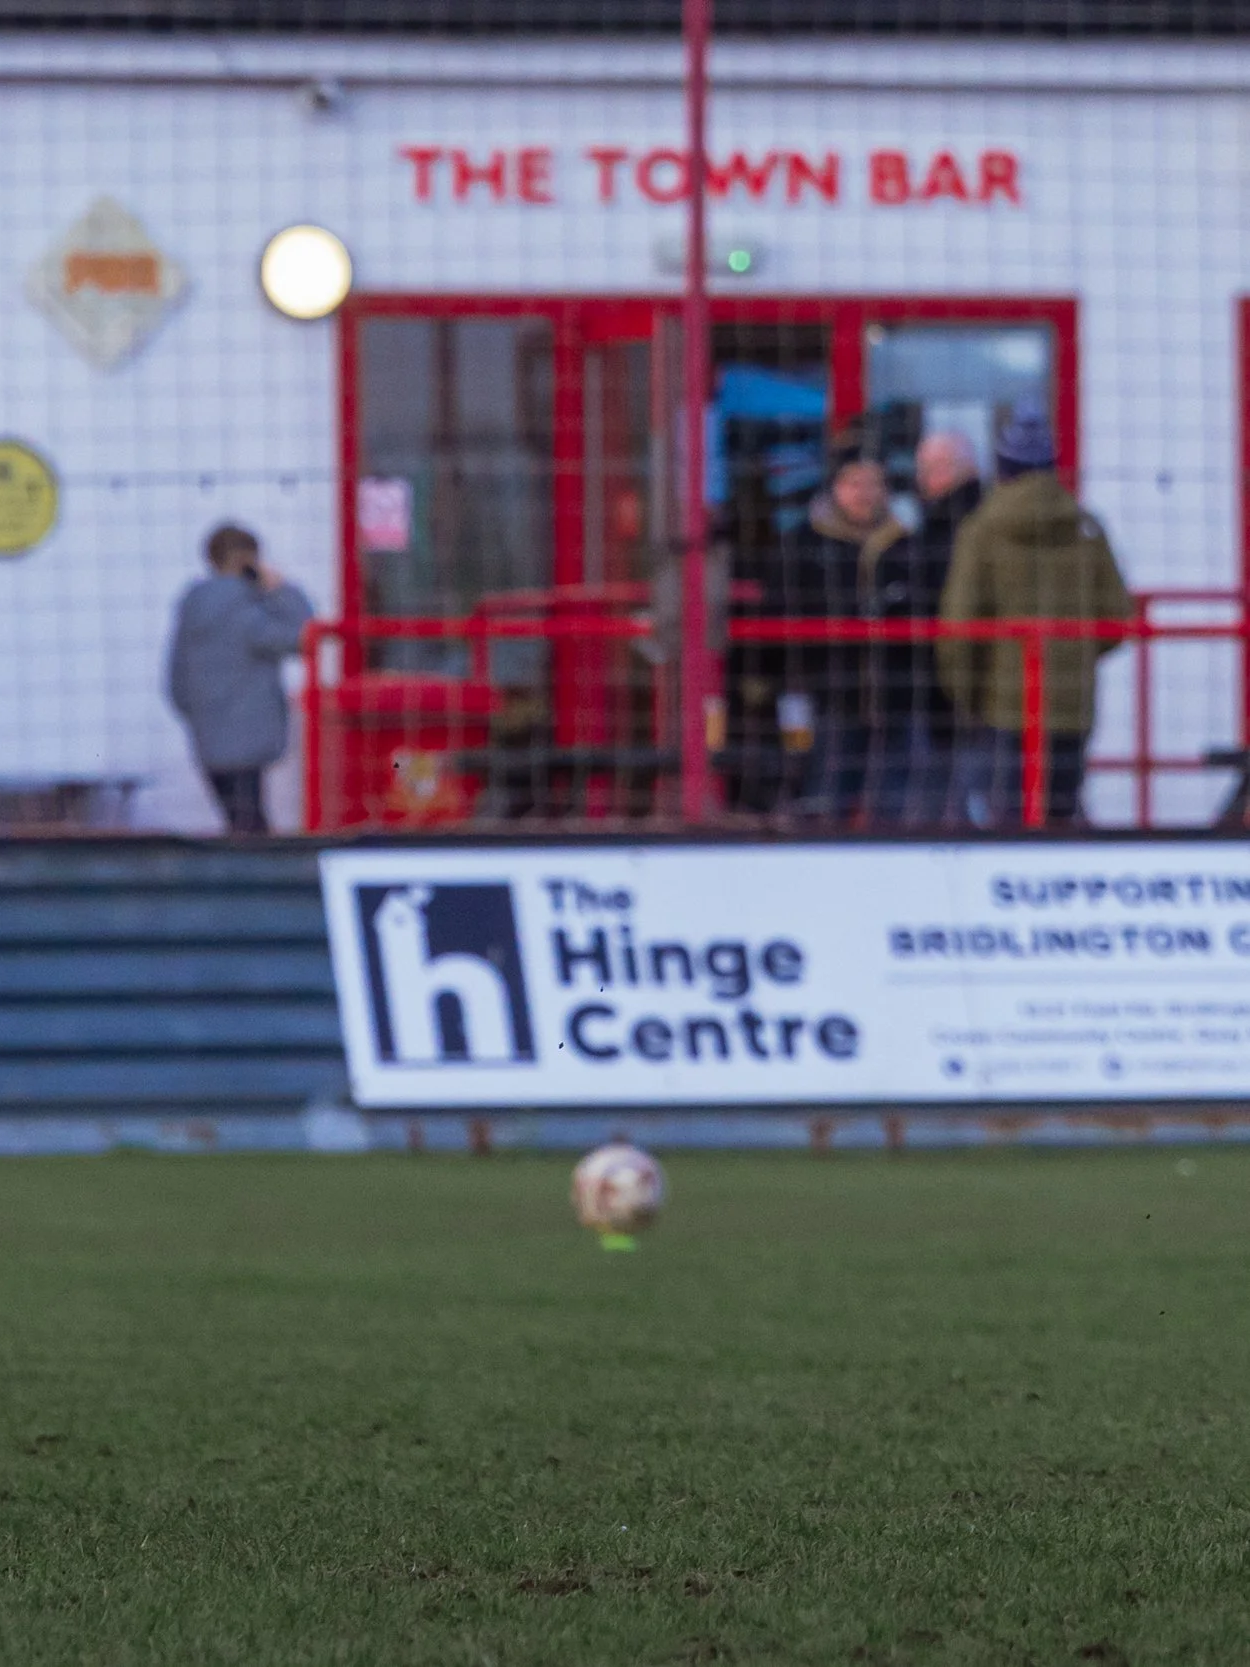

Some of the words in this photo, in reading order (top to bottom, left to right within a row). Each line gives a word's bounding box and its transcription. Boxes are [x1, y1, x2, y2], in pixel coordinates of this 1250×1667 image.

[401, 146, 552, 204] THE
[585, 146, 840, 204] TOWN
[869, 149, 1021, 206] BAR
[543, 878, 634, 913] The
[552, 924, 805, 1000] Hinge
[888, 926, 1211, 957] BRIDLINGTON
[566, 1002, 859, 1062] Centre
